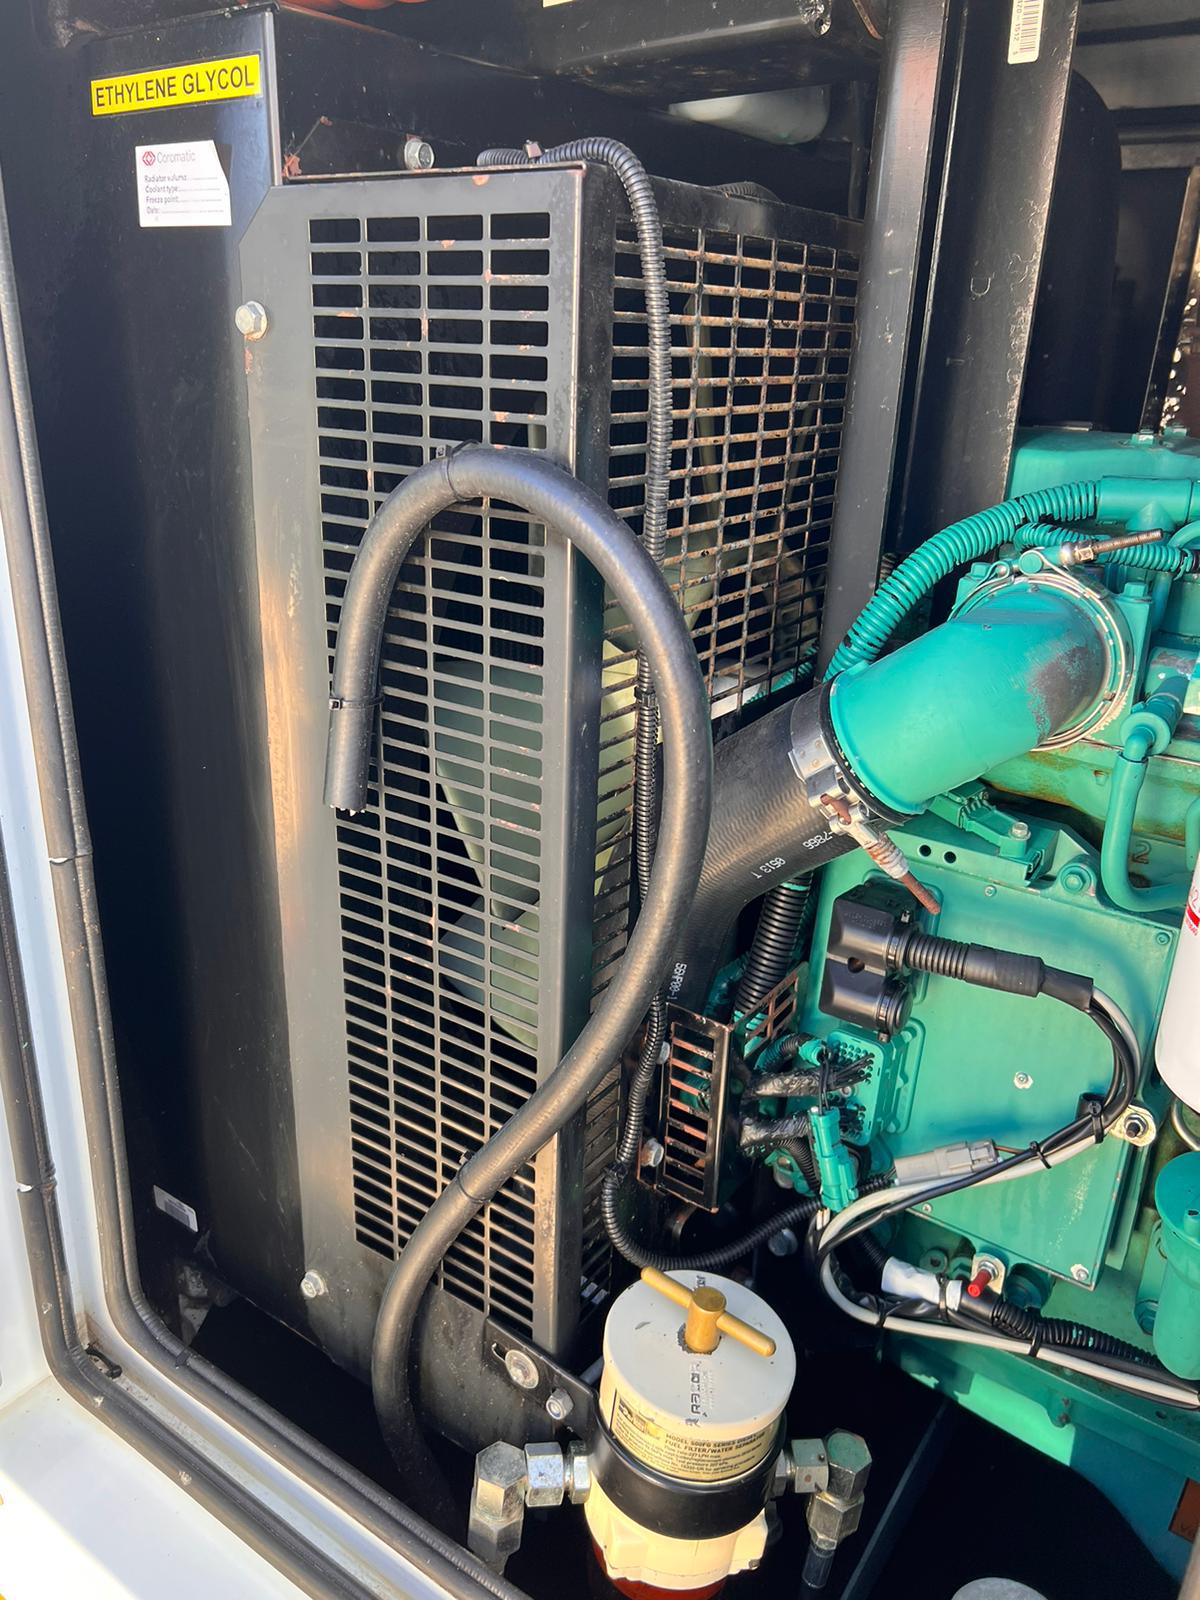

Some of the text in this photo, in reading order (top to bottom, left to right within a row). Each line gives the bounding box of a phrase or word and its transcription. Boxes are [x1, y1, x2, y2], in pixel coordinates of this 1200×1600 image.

[96, 65, 255, 107] ETHYLENE GLYCOL
[157, 150, 196, 164] Coromatic
[144, 175, 166, 183] Radiator
[145, 185, 166, 193] Coolant
[665, 1433, 688, 1445] MODEL
[665, 1439, 683, 1449] FUEL
[684, 1445, 733, 1453] FILTER/WATER
